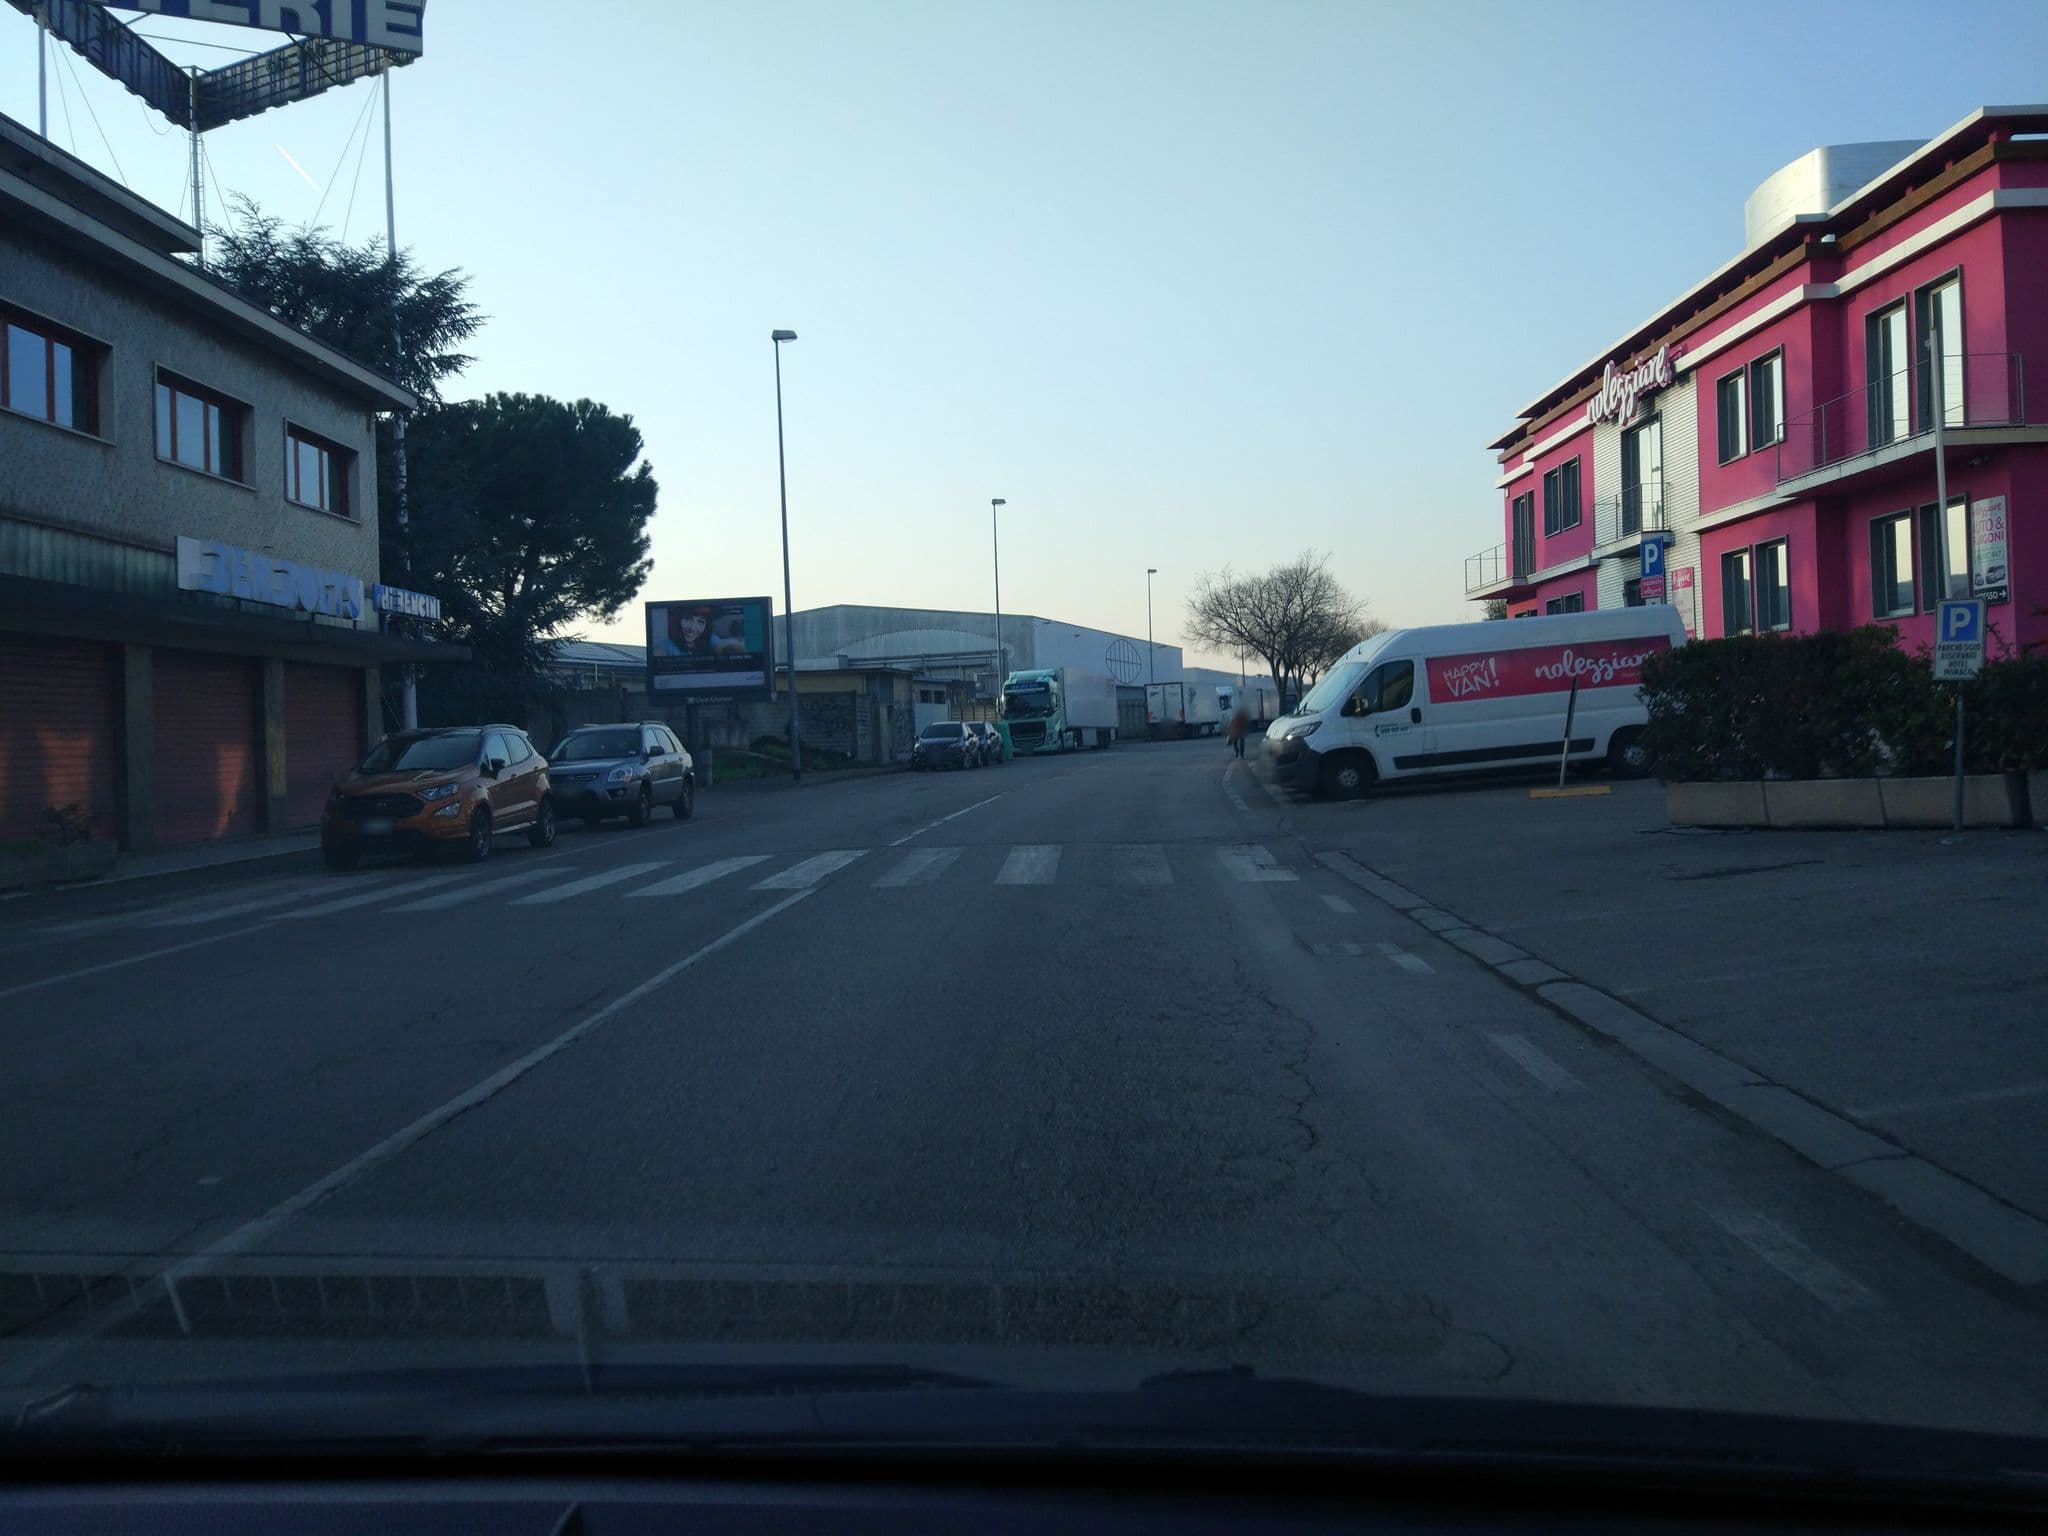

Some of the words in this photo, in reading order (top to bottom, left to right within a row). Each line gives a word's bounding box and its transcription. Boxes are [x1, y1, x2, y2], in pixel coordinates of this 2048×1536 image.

[1587, 343, 1671, 426] noleggiare
[1645, 543, 1659, 574] P
[1949, 607, 1971, 638] P
[1442, 658, 1486, 680] HAPPY
[1535, 649, 1655, 685] noleggiar
